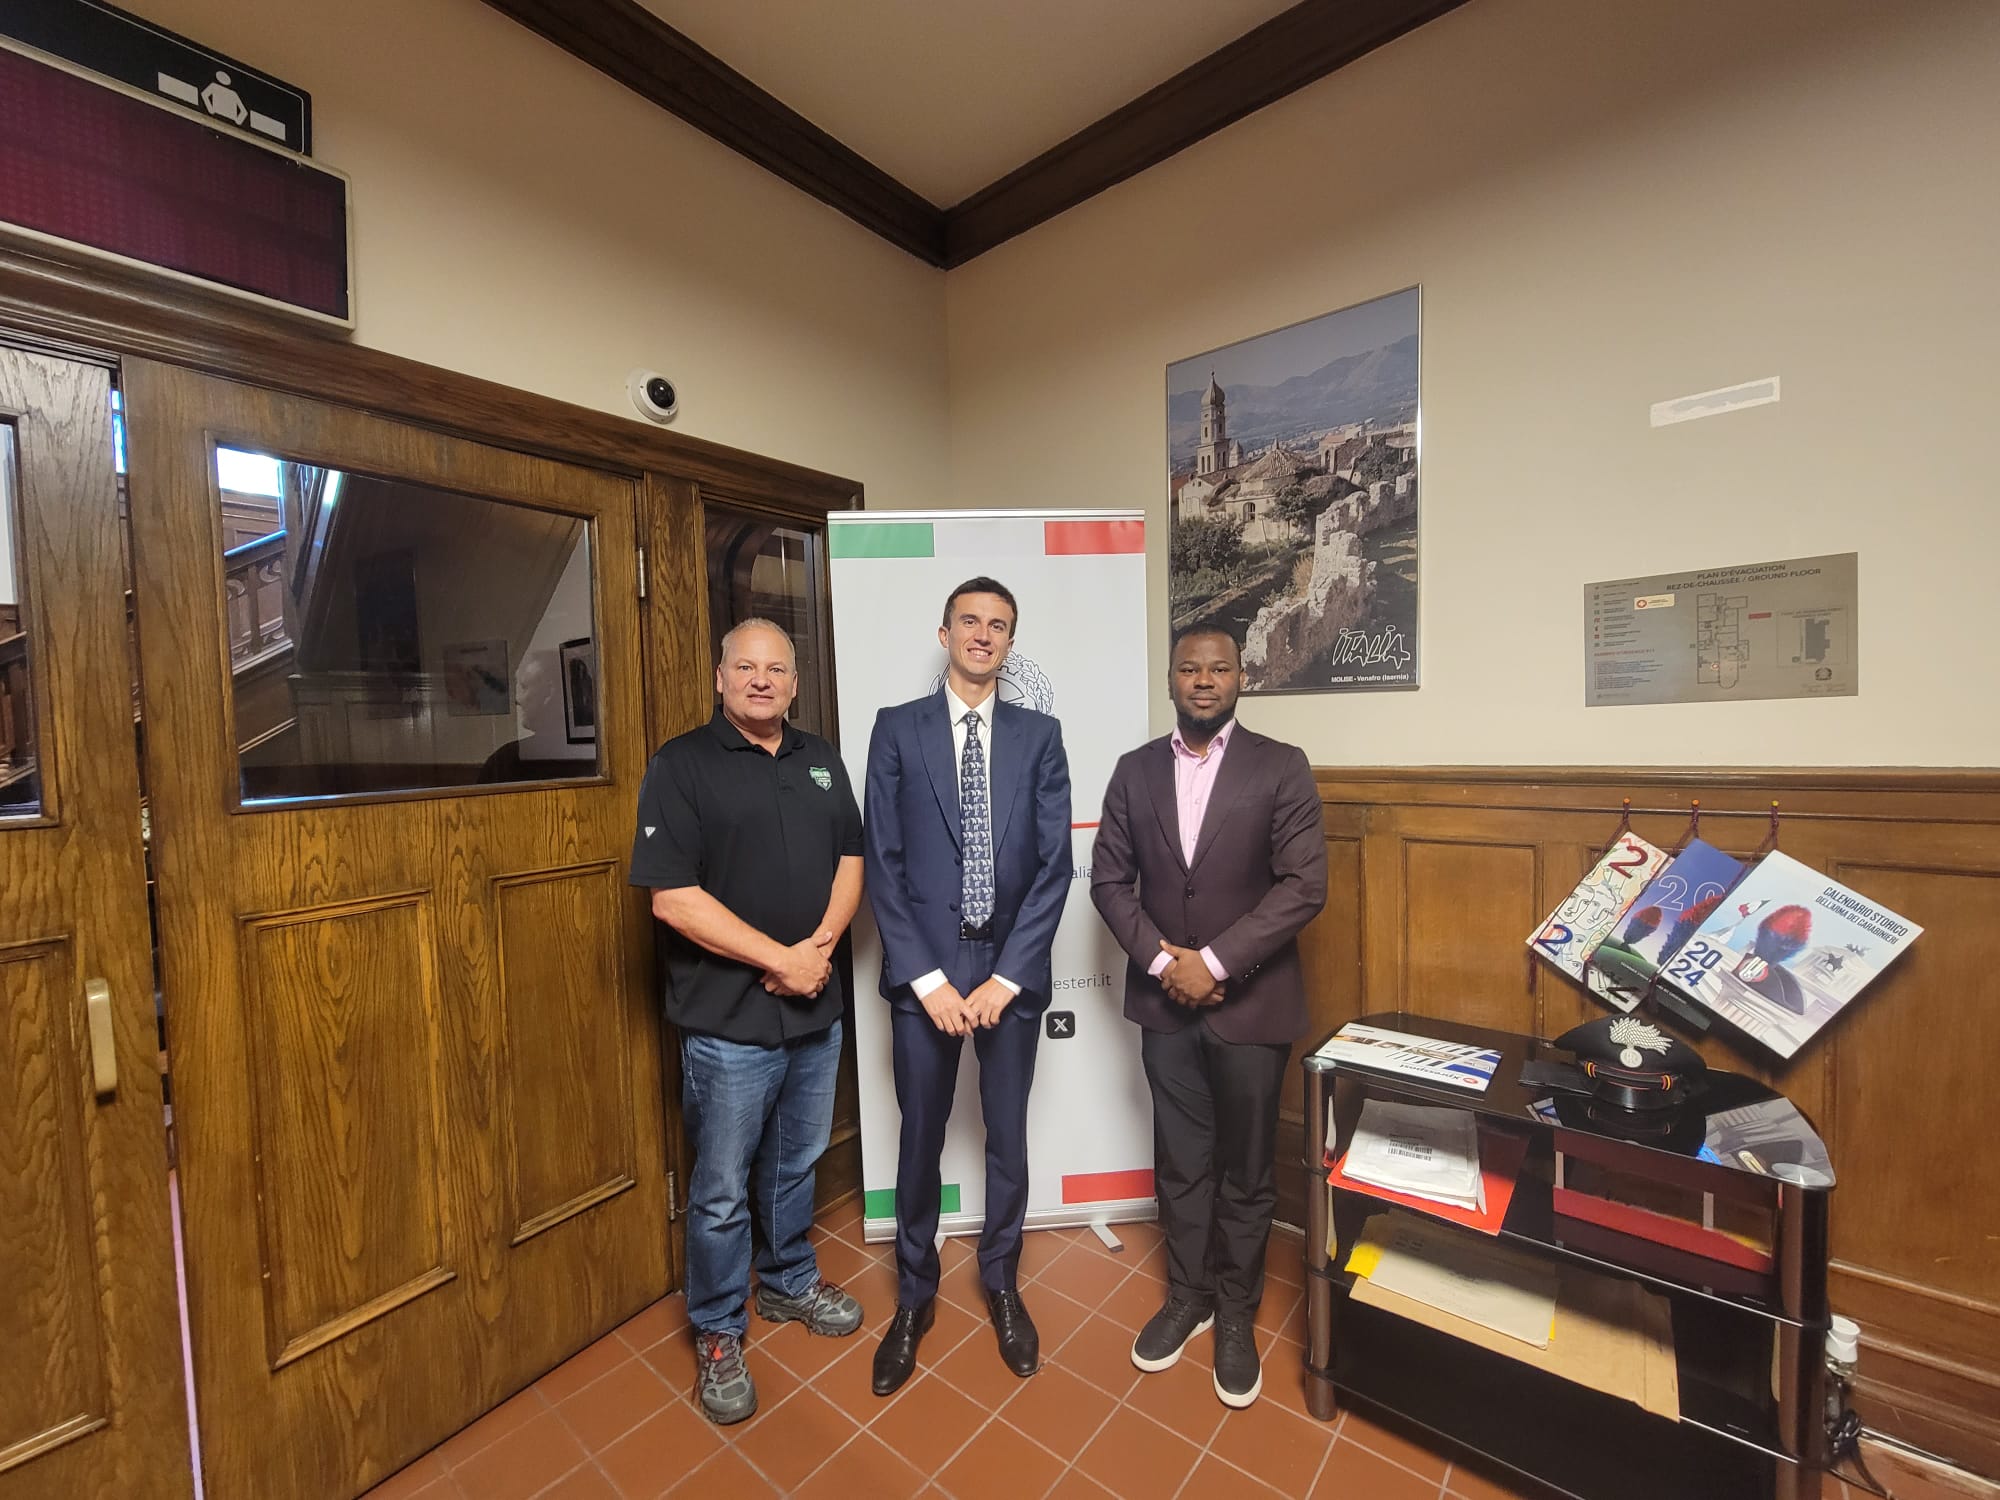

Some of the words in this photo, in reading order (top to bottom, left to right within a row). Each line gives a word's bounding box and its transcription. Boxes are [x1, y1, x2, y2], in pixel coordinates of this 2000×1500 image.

[1697, 571, 1719, 580] PLAN
[1748, 571, 1788, 583] GROUND
[1790, 568, 1821, 578] FLOOR
[1823, 886, 1874, 918] CALENDARIO
[1870, 912, 1909, 937] STORICO
[1846, 911, 1860, 925] DEI
[1857, 917, 1900, 945] CARABINIERI
[1684, 941, 1724, 970] 20
[1667, 958, 1707, 988] 24
